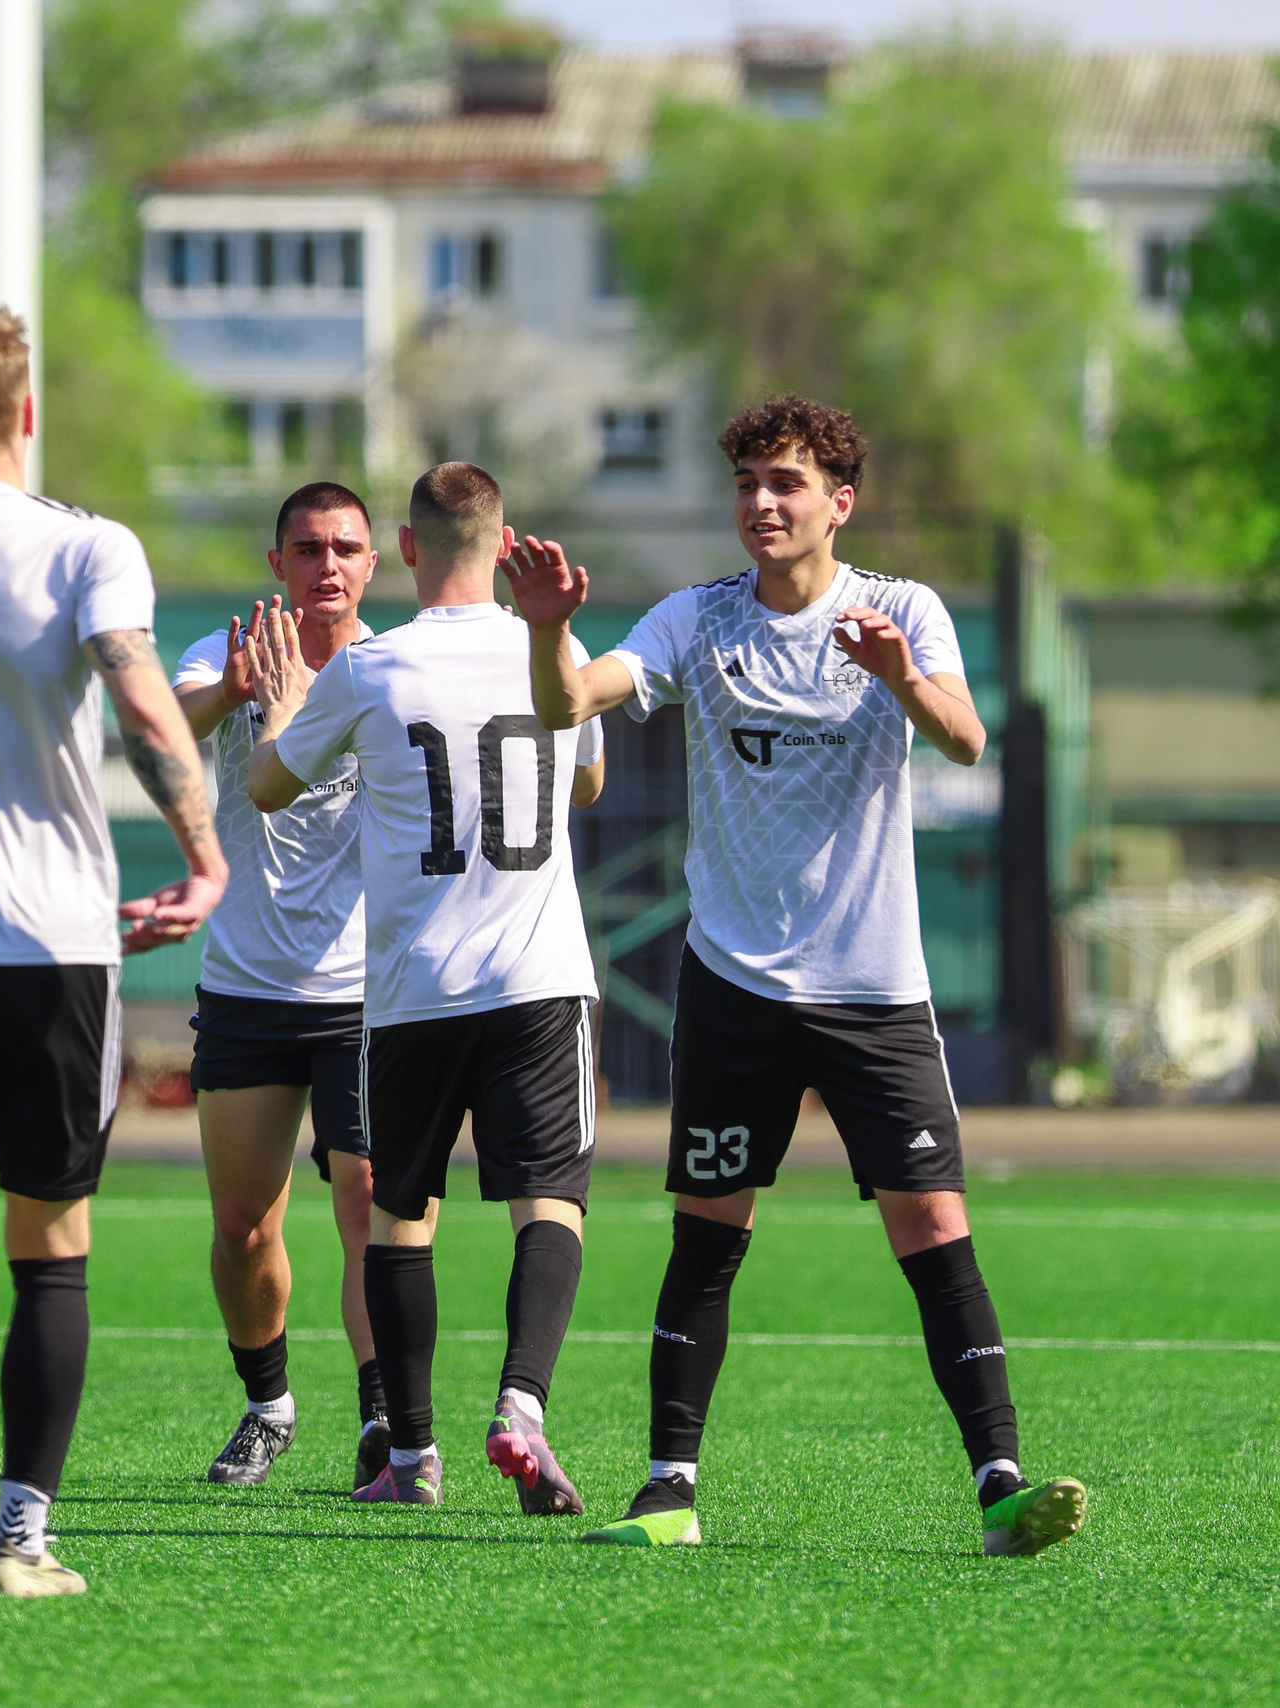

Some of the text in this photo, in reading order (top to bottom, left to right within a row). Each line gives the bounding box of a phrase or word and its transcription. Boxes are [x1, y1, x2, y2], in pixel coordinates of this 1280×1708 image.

[783, 733, 815, 746] Coin
[818, 732, 846, 745] Tab
[406, 714, 555, 876] 10
[686, 1125, 750, 1180] 23
[653, 1324, 697, 1345] ÖGEL
